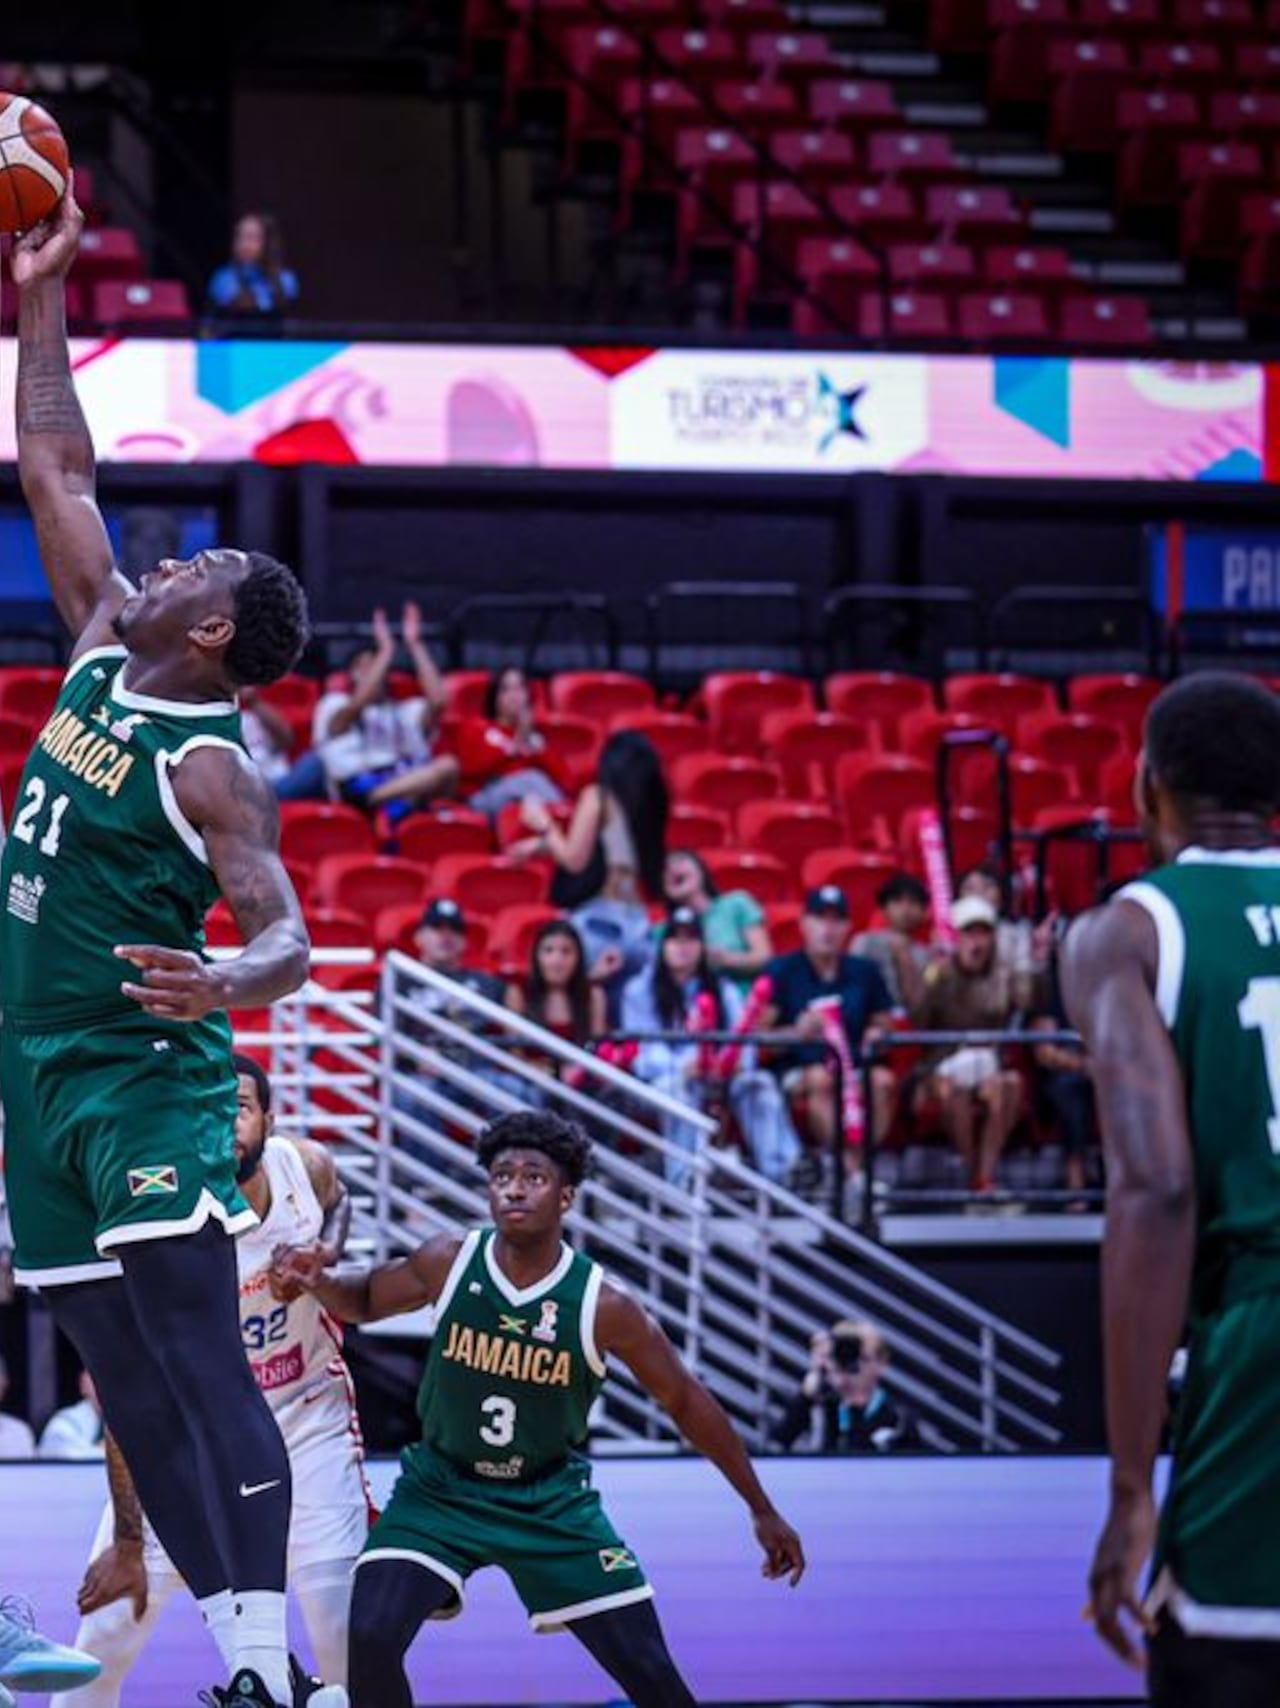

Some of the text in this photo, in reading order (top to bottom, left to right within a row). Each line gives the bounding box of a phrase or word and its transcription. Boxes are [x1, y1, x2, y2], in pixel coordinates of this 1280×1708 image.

[38, 708, 135, 798] AMAICA
[13, 776, 70, 857] 21
[242, 1304, 288, 1349] 32
[442, 1321, 571, 1386] JAMAICA
[479, 1394, 516, 1447] 3
